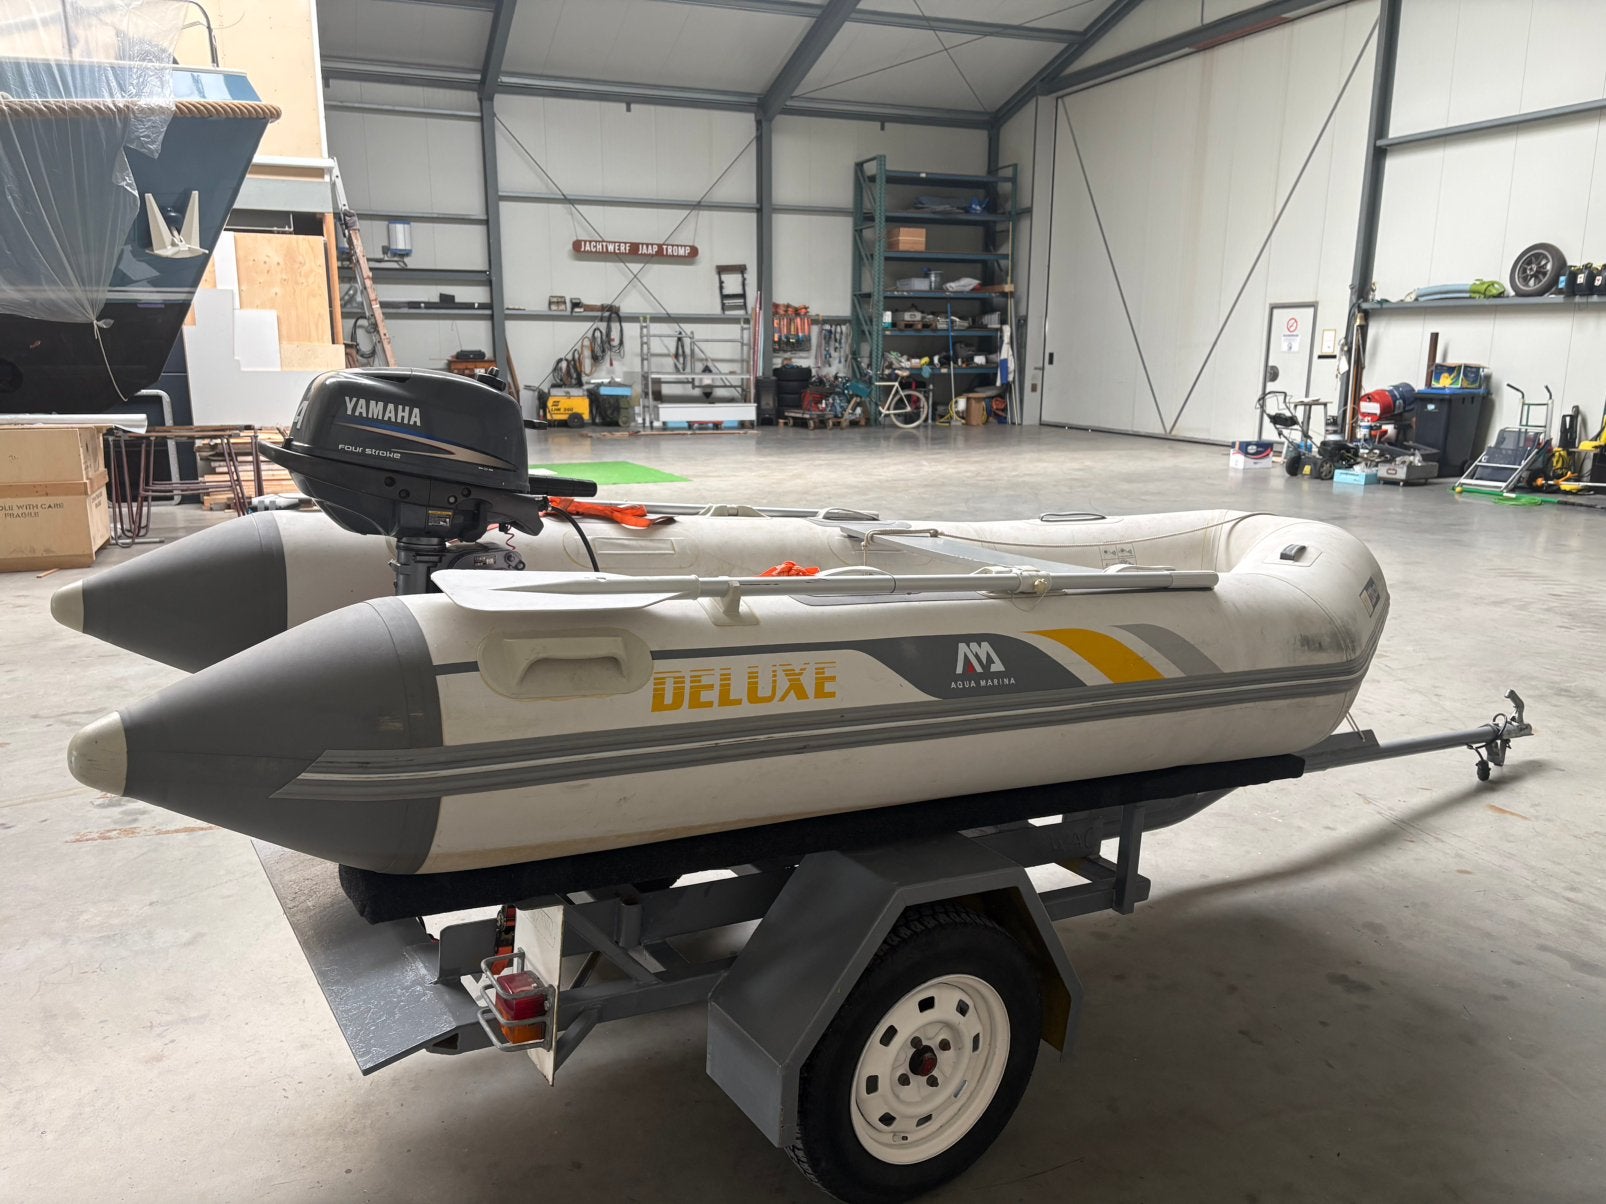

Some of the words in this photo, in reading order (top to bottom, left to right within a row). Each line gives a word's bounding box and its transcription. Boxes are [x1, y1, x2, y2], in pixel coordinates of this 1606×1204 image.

[581, 241, 631, 254] JACHTWERF
[638, 243, 658, 255] JAAP
[662, 245, 691, 256] TROMP
[344, 396, 421, 426] YAMAHA
[16, 503, 39, 511] WITH
[40, 502, 64, 510] CARE
[4, 511, 40, 519] FRAGILE
[651, 661, 837, 712] DELUXE
[951, 680, 976, 689] AQUA
[980, 677, 1016, 687] MARINA
